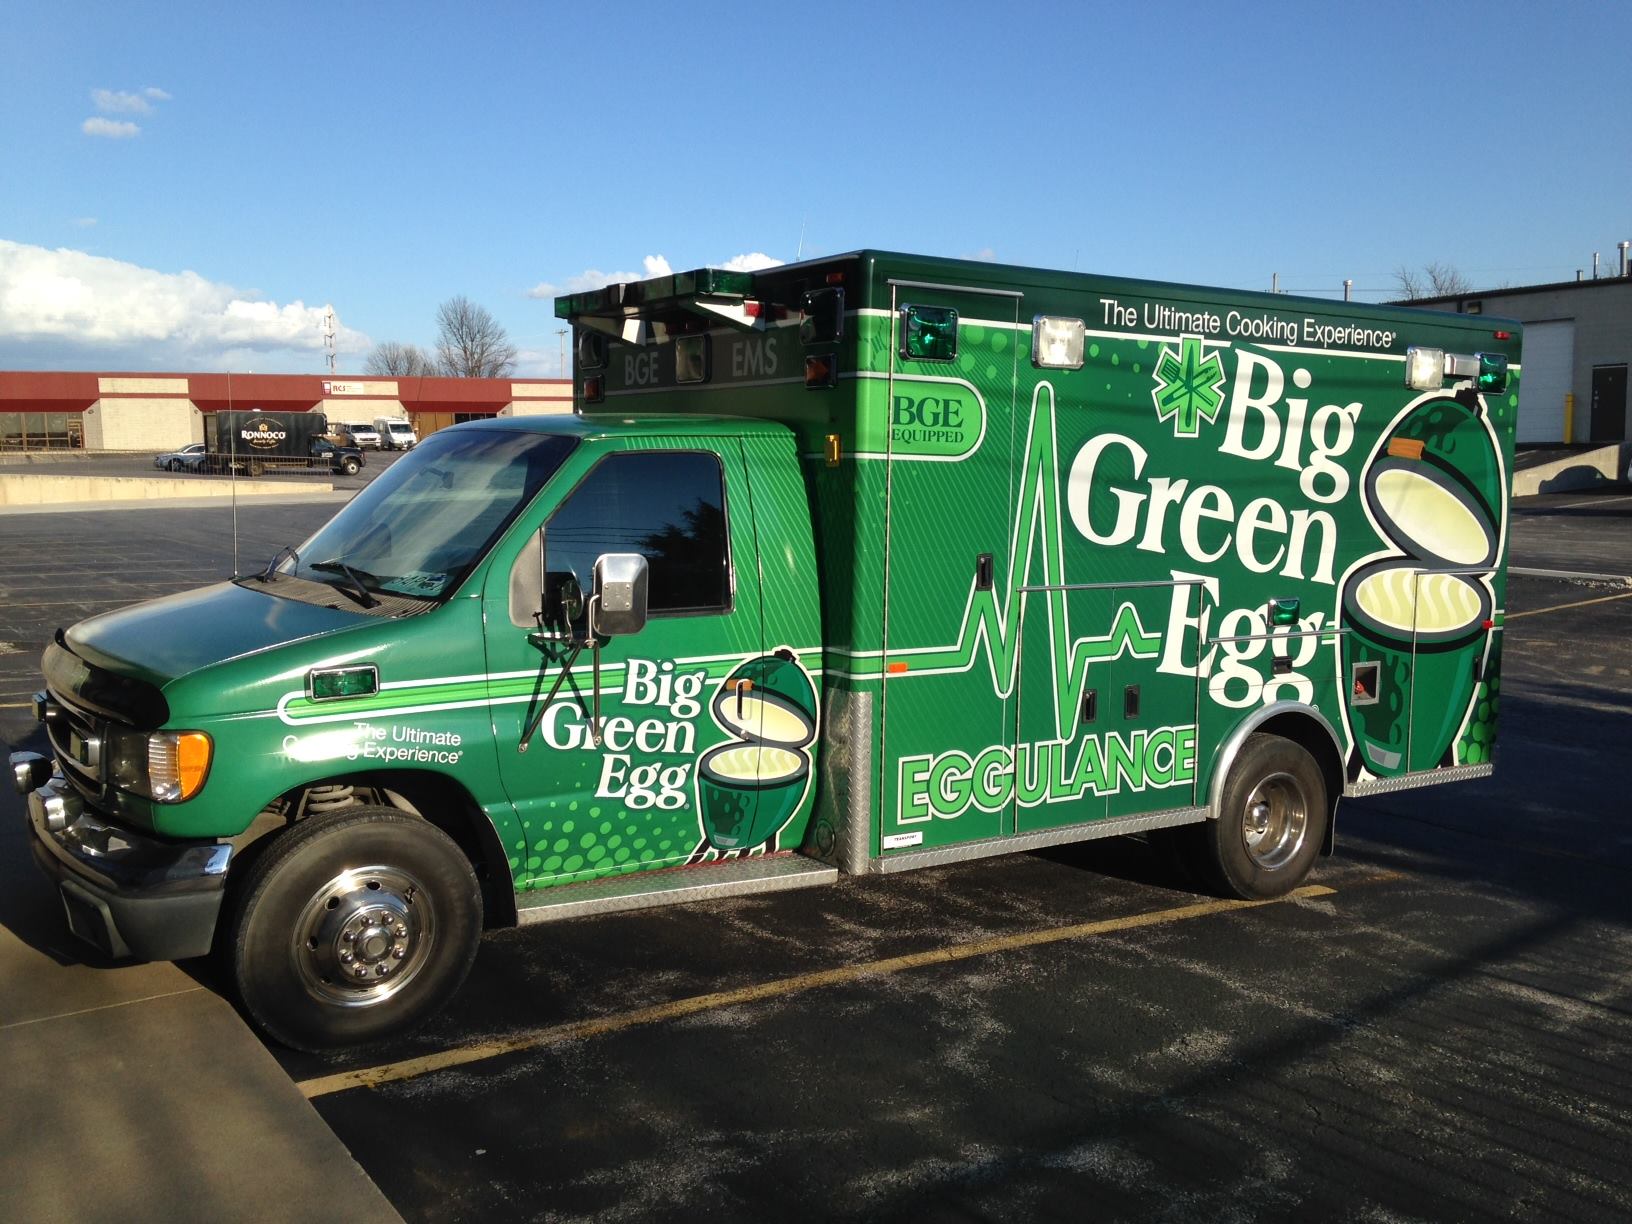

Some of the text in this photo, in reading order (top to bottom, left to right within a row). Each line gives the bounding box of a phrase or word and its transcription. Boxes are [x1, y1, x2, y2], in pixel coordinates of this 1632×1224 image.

[1099, 299, 1393, 348] The Ultimate Cooking Experience
[624, 339, 778, 386] BGE EMS
[241, 430, 286, 440] RONNOCO
[892, 395, 964, 428] BGE
[892, 428, 964, 444] EQUIPPED
[1218, 348, 1363, 504] Big
[1067, 433, 1337, 586] Green
[1156, 569, 1326, 709] Egg
[622, 658, 705, 719] Big
[354, 722, 462, 747] The Ultimate
[363, 741, 460, 764] Experience
[541, 702, 695, 754] Green
[594, 754, 691, 810] Egg
[897, 724, 1198, 824] EGGULANCE
